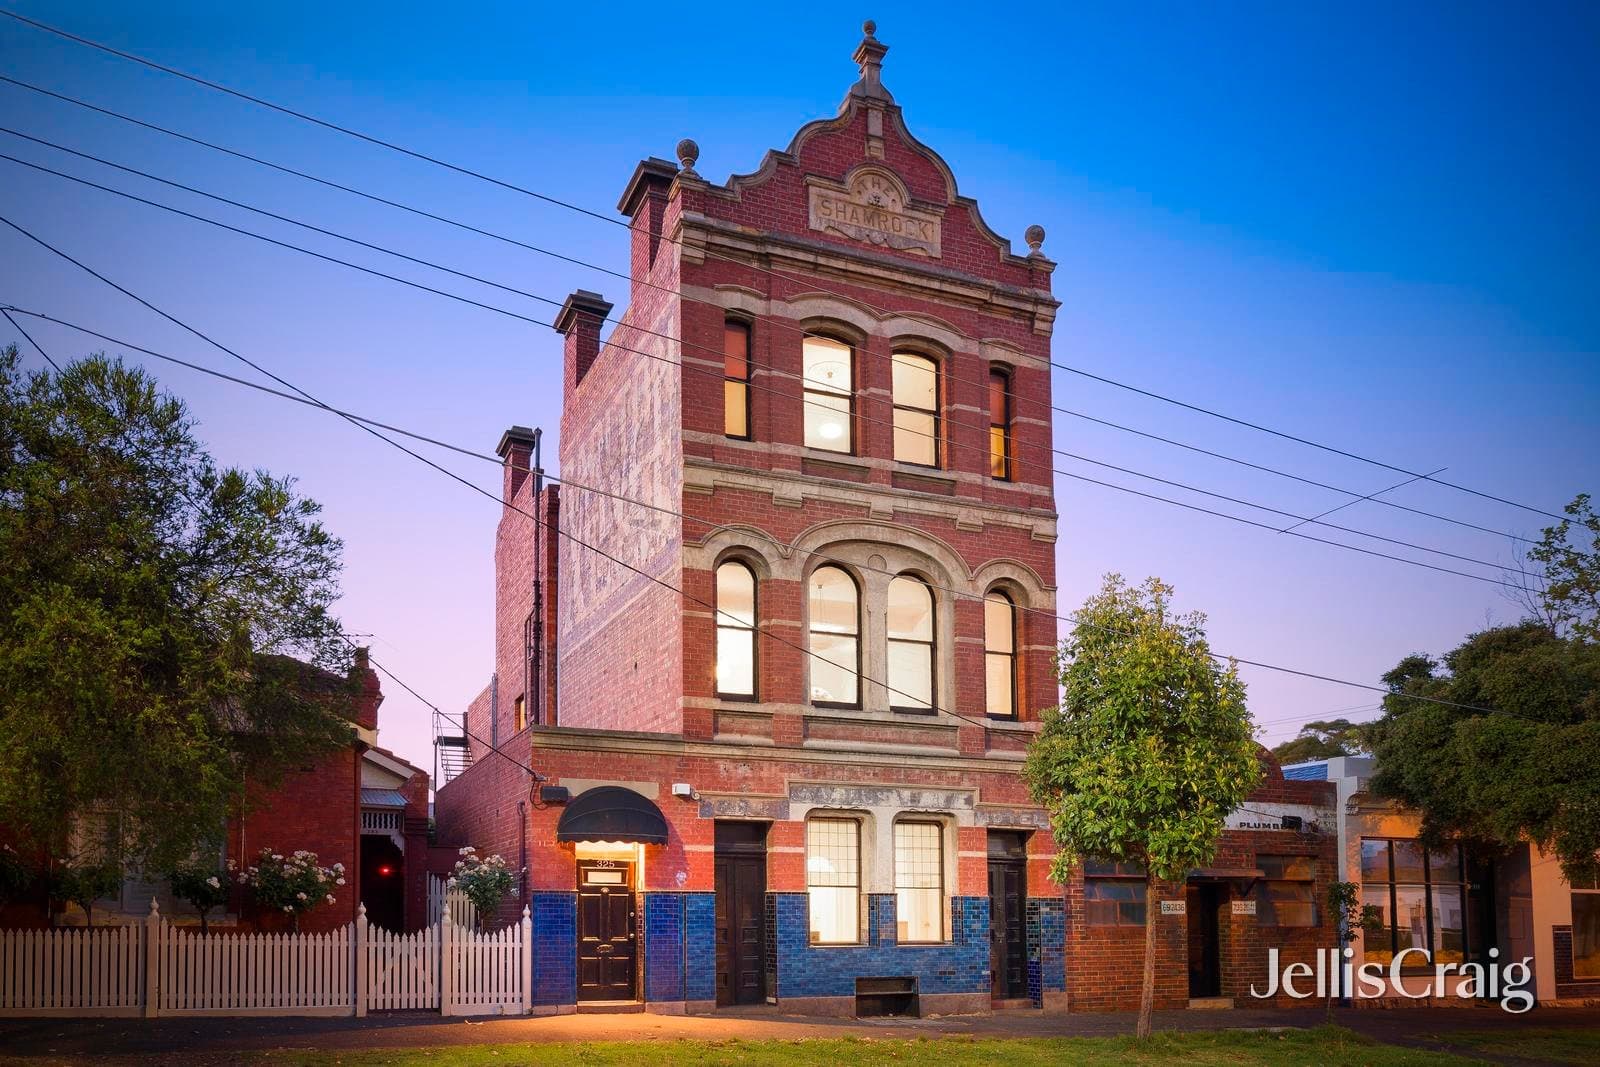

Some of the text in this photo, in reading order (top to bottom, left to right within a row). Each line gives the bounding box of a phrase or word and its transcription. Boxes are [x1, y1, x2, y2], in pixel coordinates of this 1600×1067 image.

[858, 177, 896, 198] THE
[820, 199, 929, 240] SHAMROCK
[596, 860, 615, 868] 325
